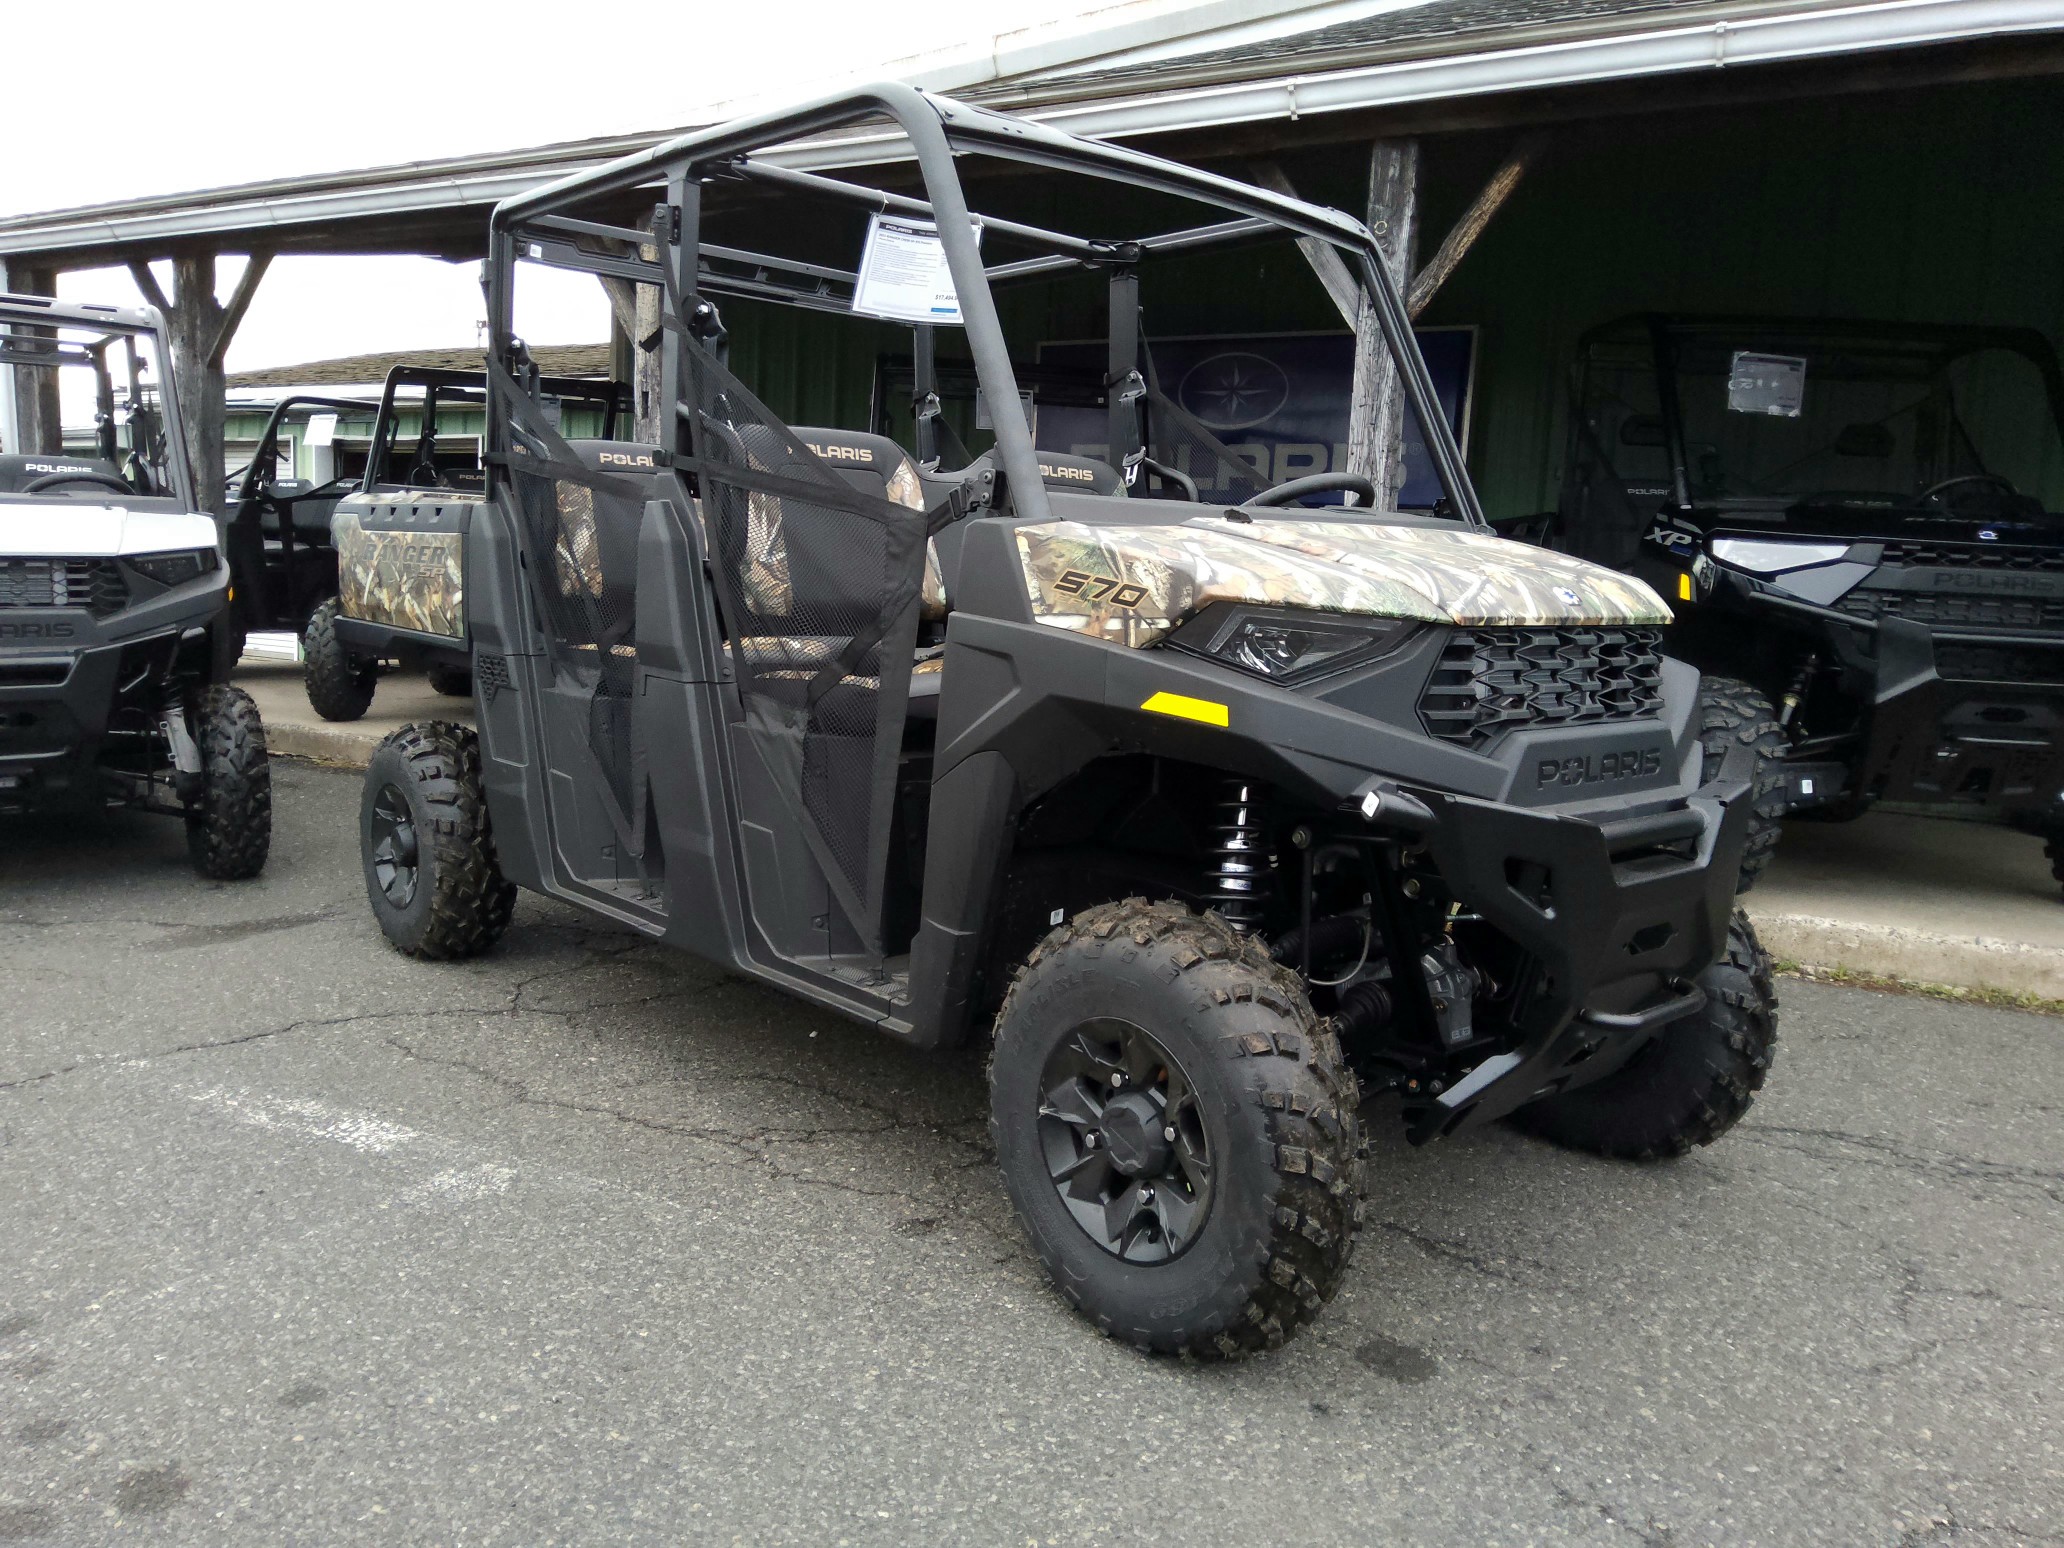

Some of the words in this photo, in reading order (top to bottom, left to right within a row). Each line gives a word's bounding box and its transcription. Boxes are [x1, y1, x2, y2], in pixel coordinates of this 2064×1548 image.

[599, 452, 655, 467] POLA
[804, 443, 873, 462] OLARIS
[1038, 464, 1094, 481] OLARIS
[1627, 488, 1671, 496] POLARI
[1643, 526, 1692, 546] XP
[362, 543, 448, 565] RANGER
[417, 565, 446, 578] SP
[1053, 568, 1150, 609] 570
[1932, 572, 2056, 592] POLARIS
[1537, 747, 1661, 791] POLARIS
